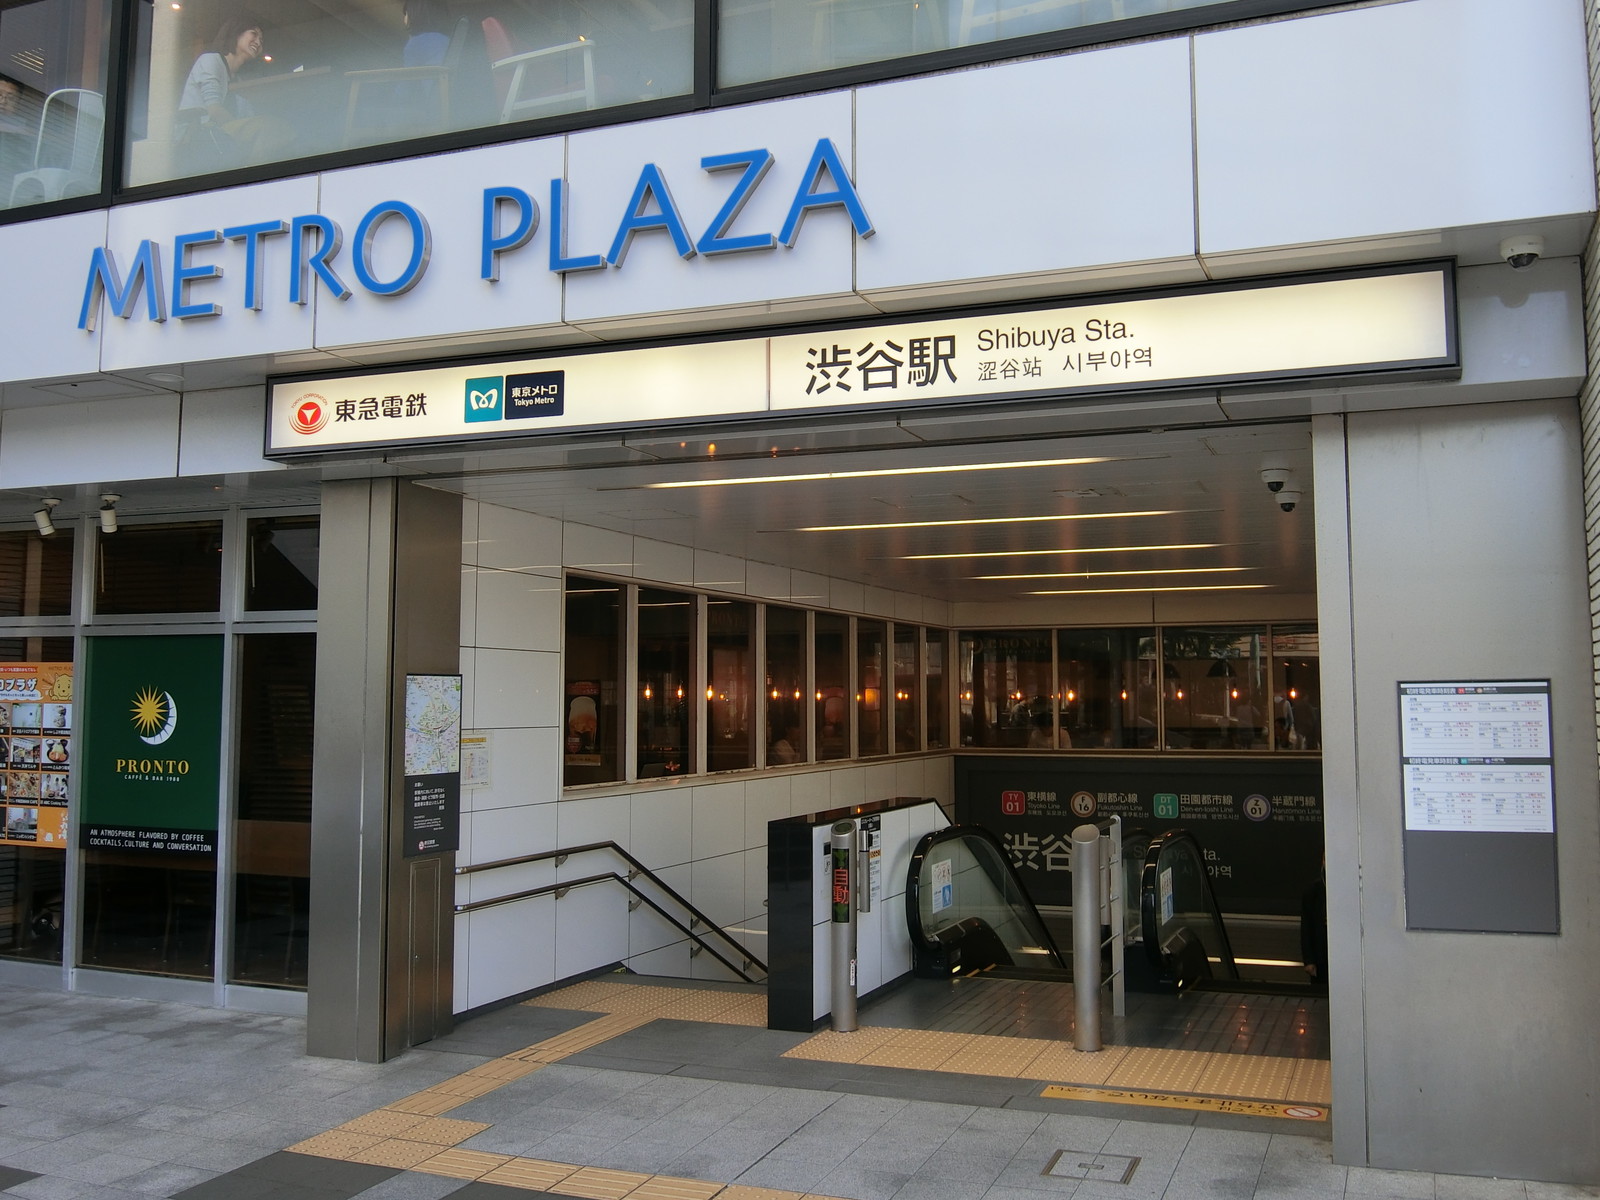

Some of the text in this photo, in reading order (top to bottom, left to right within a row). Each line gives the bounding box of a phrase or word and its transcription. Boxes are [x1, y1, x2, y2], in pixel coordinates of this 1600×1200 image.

[77, 137, 875, 331] METRO PLAZA
[977, 319, 1135, 352] Shibuya Sta.
[805, 335, 957, 394] 渋谷駅
[1062, 347, 1153, 373] 시부야역
[977, 358, 1042, 382] 涩谷站
[511, 384, 558, 398] 東京メトロ
[335, 393, 427, 422] 東急電鉄
[514, 398, 534, 407] Tokyo
[116, 759, 189, 775] PRONTO
[1027, 792, 1057, 802] 東横線
[1097, 792, 1138, 803] 副都心線
[1160, 796, 1171, 804] DT
[1180, 794, 1233, 805] 田園都市線
[1272, 795, 1316, 807] 半蔵門線
[1006, 802, 1020, 812] 01
[1079, 803, 1090, 811] 16
[1158, 805, 1172, 816] 01
[1250, 807, 1262, 815] 01
[100, 829, 135, 838] ATMOSPHERE
[139, 831, 168, 840] FLAVORED
[181, 833, 204, 842] COFFEE
[153, 841, 164, 849] AND
[166, 843, 212, 852] CONVERSATION
[834, 867, 849, 904] 自動
